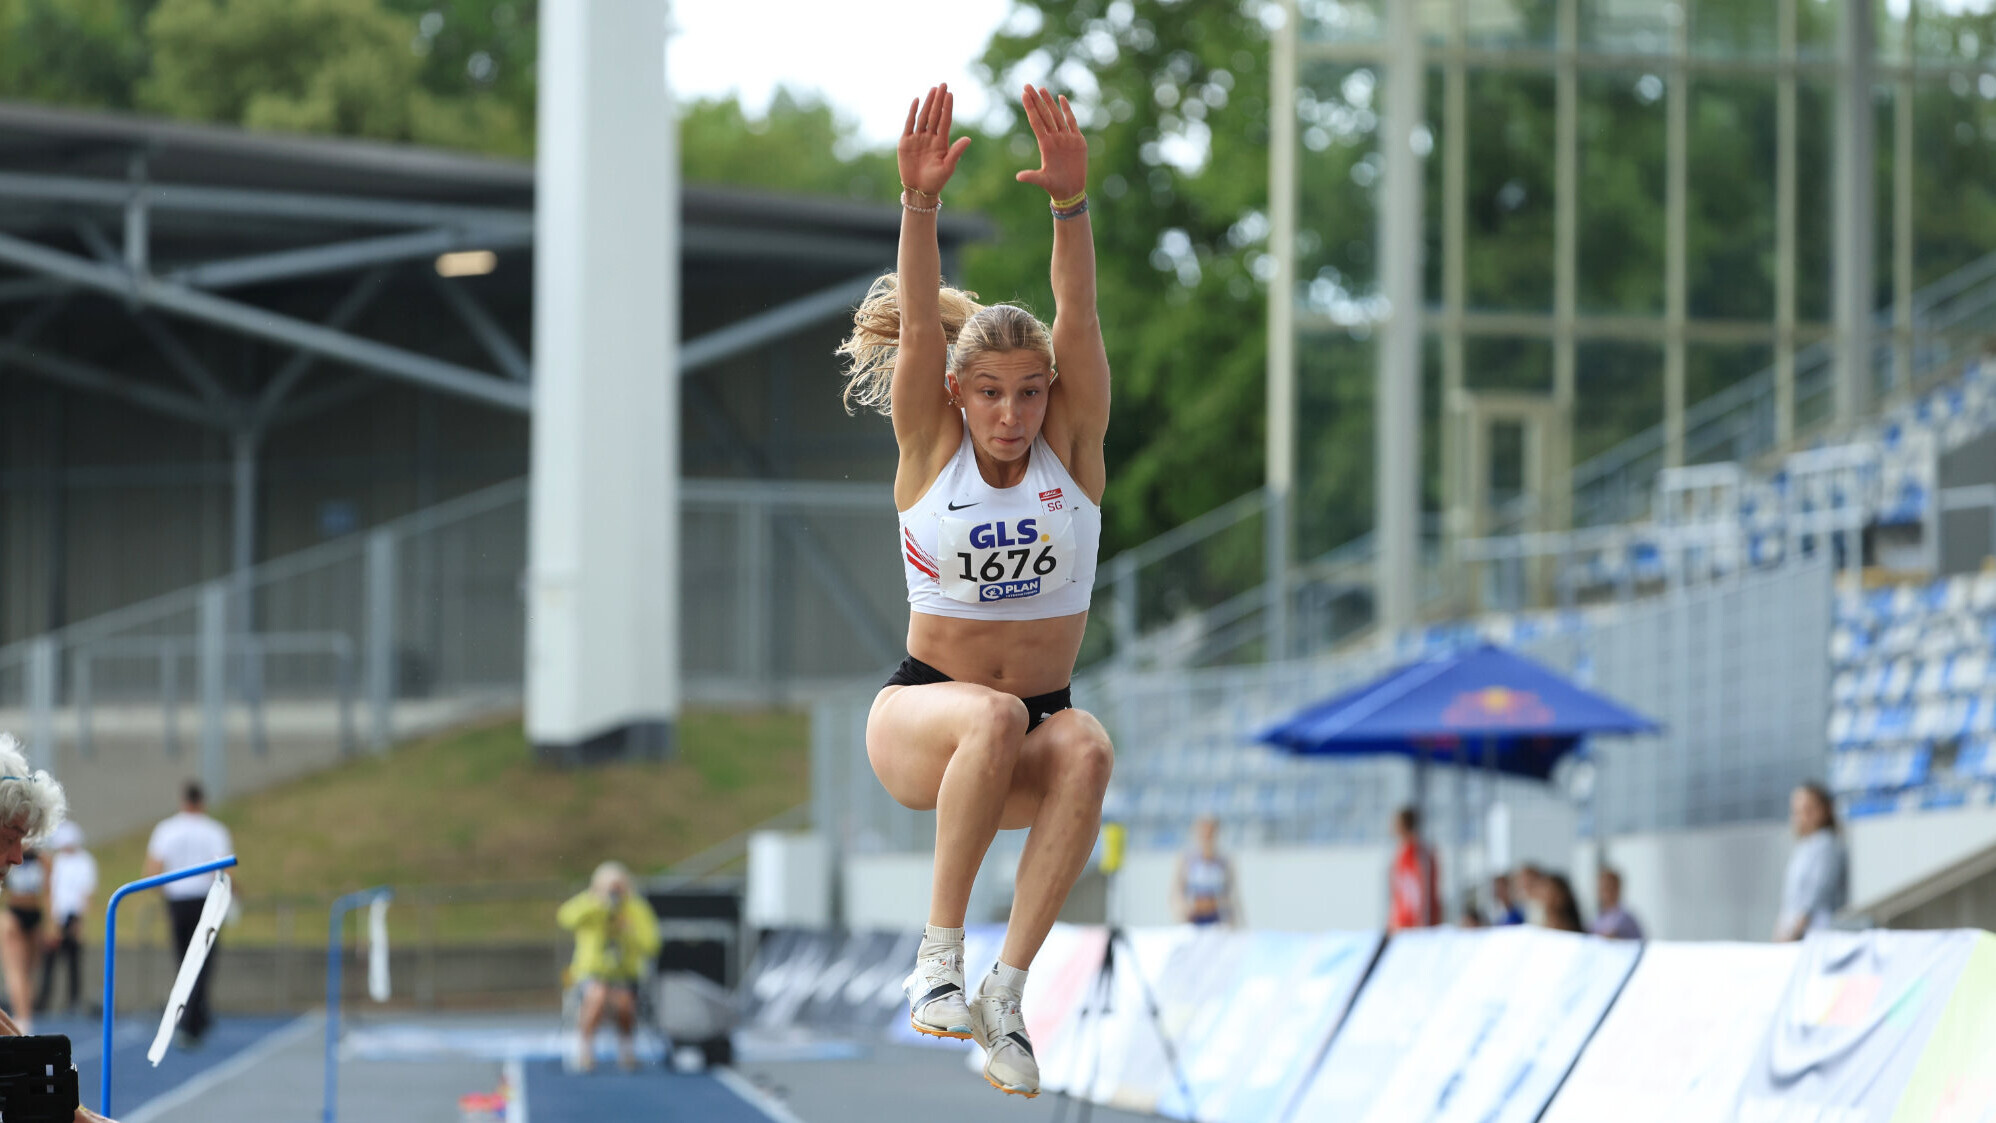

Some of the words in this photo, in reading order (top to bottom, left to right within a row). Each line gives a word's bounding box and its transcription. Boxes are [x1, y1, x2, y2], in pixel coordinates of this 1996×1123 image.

[1047, 500, 1063, 512] SG
[957, 545, 1057, 583] 1676
[1005, 581, 1038, 594] PLAN
